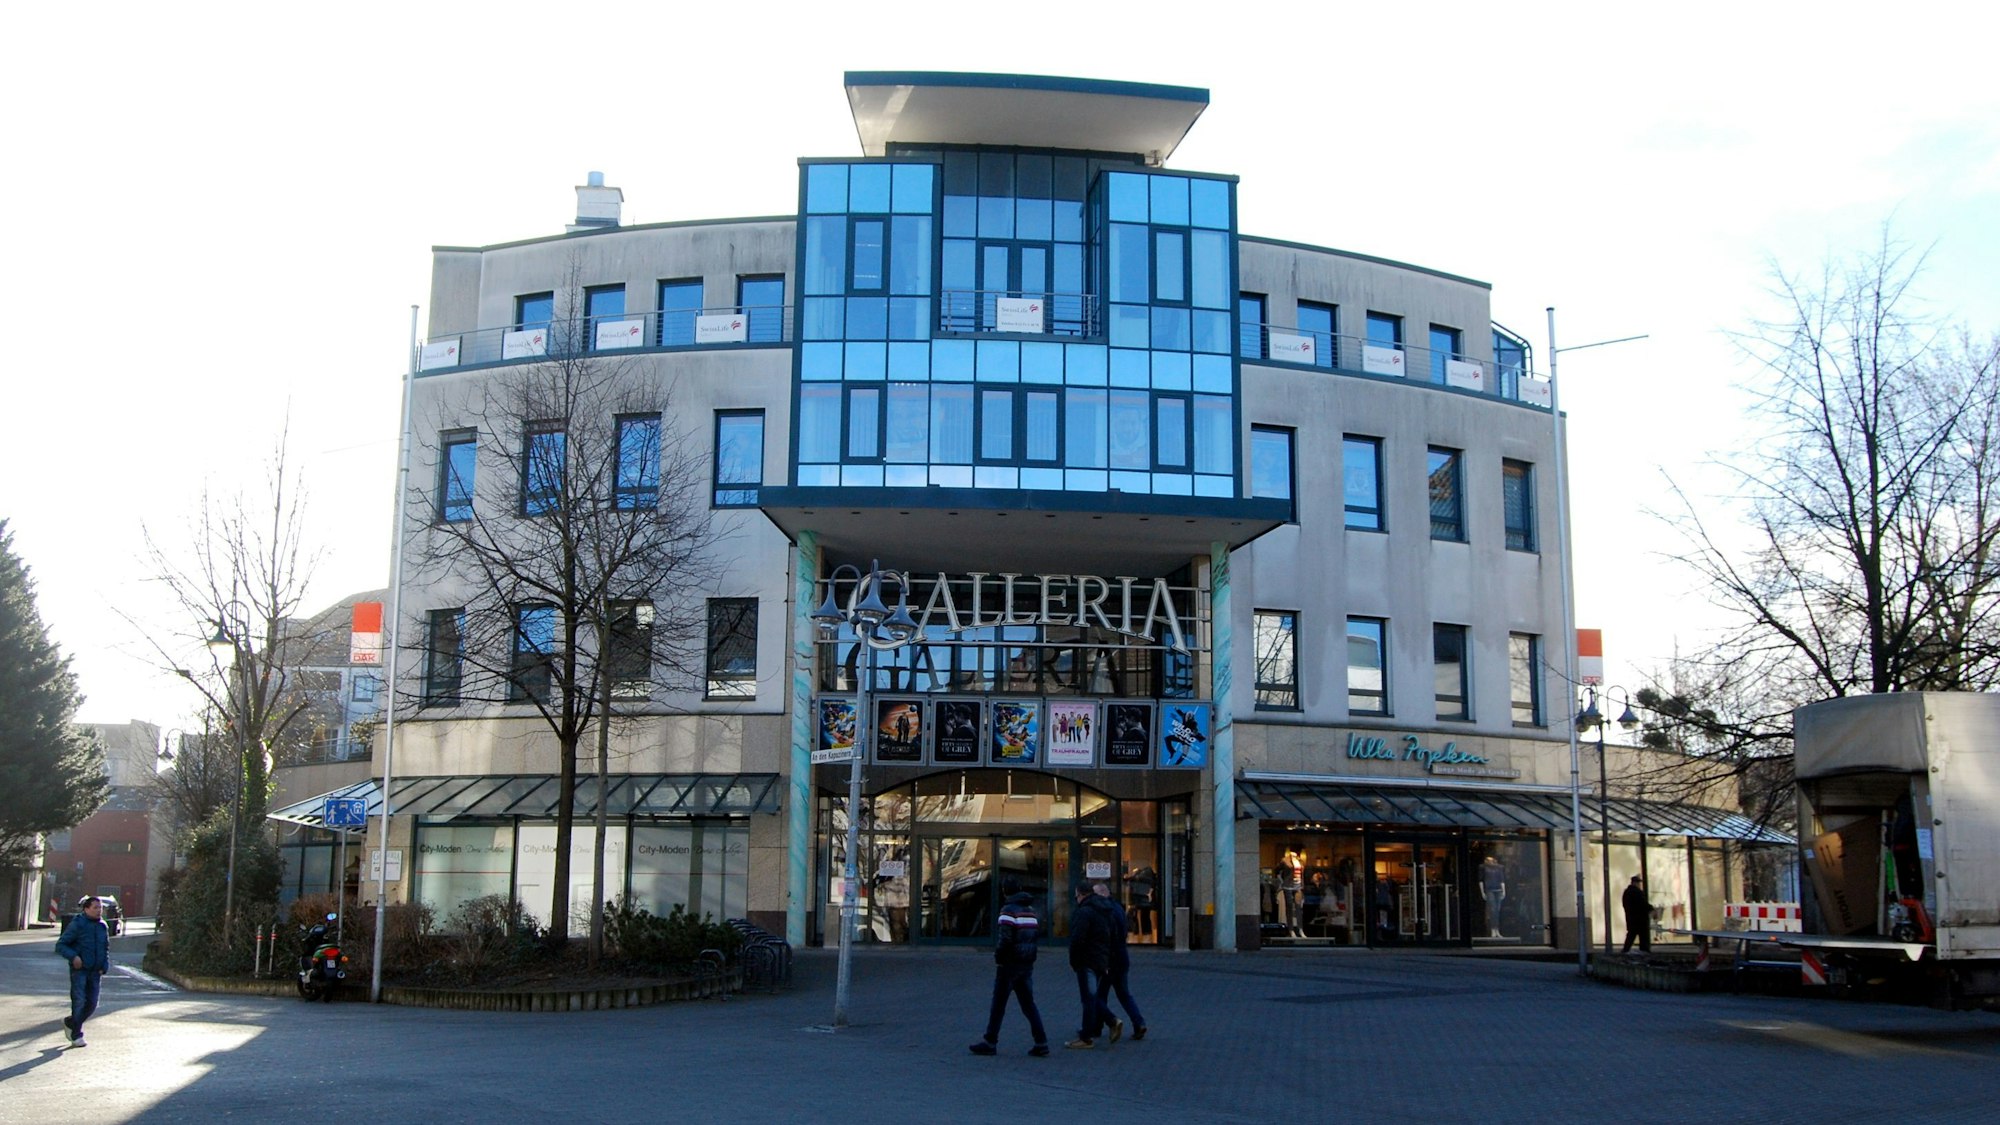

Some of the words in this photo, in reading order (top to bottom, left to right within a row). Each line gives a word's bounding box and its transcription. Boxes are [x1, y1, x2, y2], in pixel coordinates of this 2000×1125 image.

[847, 571, 1191, 656] GALLERIA
[1347, 732, 1397, 761] Ulla
[1402, 735, 1490, 772] Popken
[419, 844, 462, 855] City-Moden
[523, 844, 558, 855] City-Mo
[638, 844, 690, 856] City-Moden
